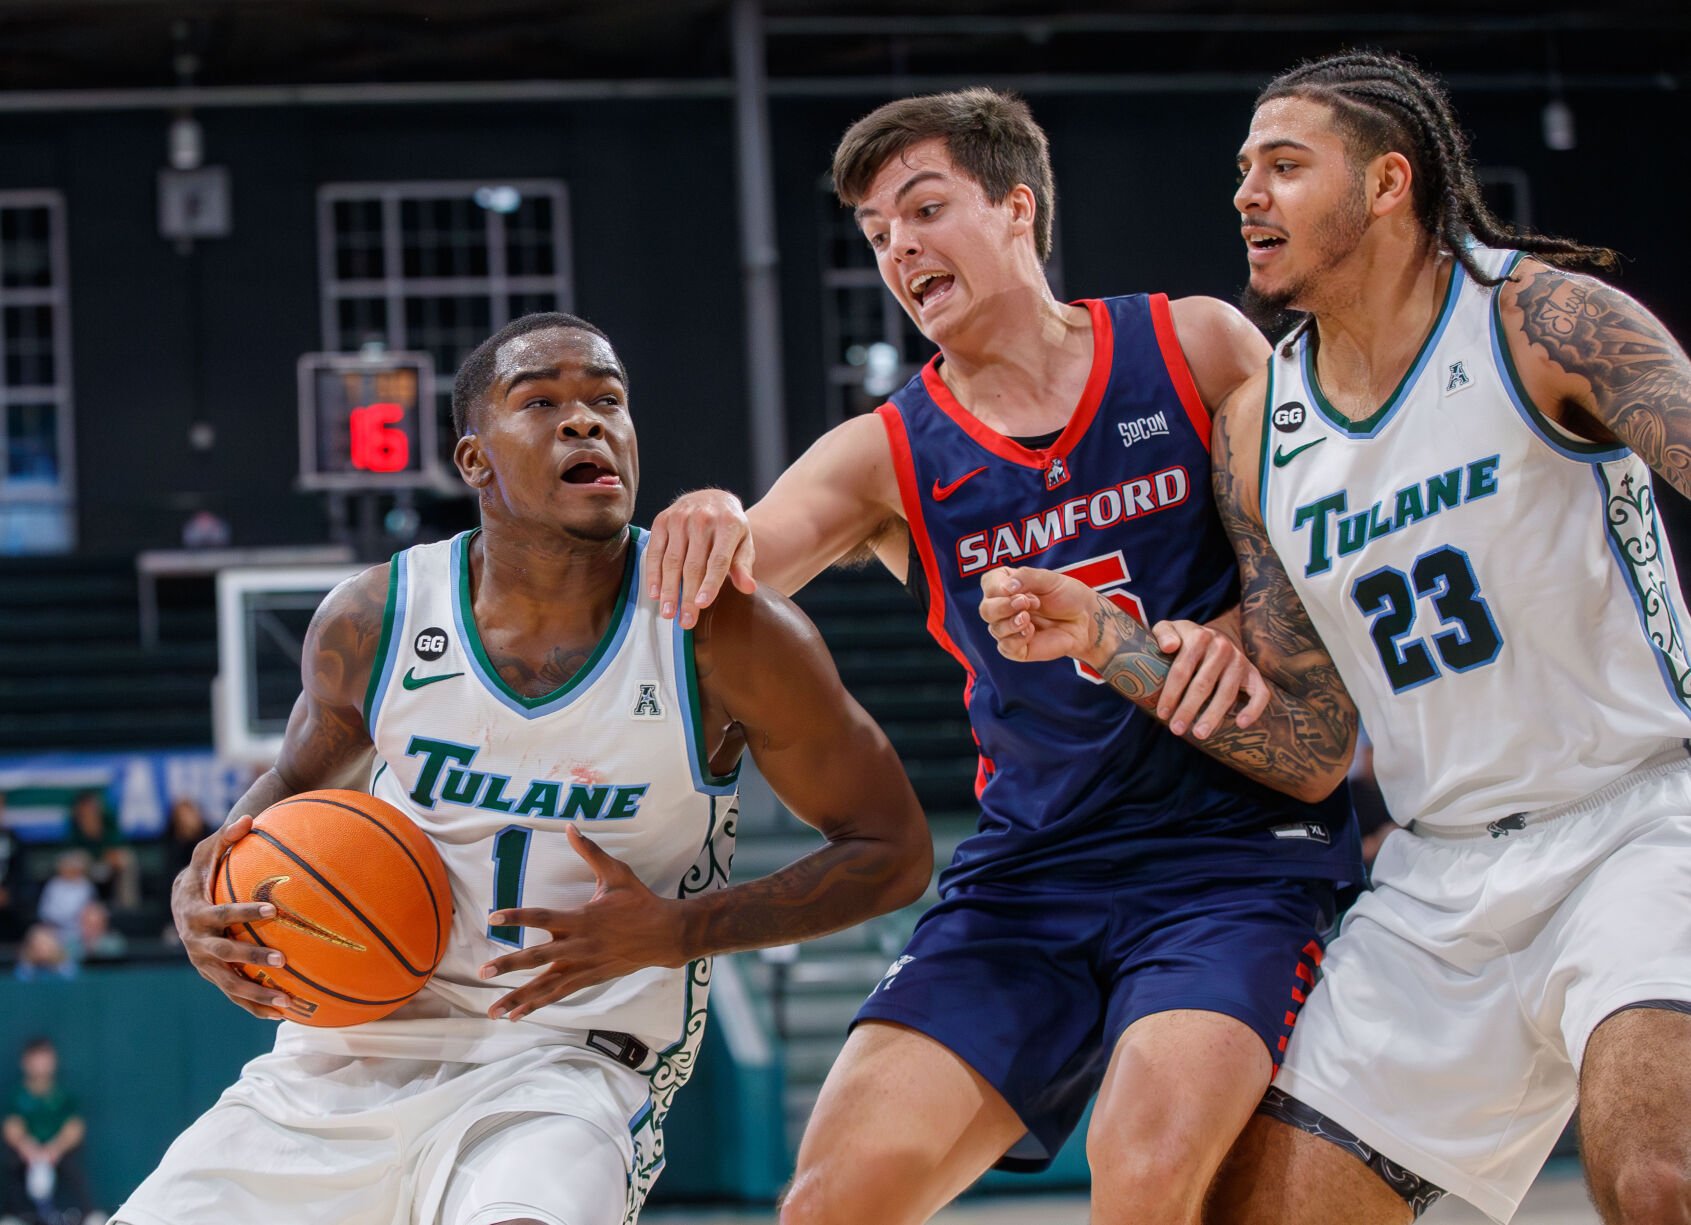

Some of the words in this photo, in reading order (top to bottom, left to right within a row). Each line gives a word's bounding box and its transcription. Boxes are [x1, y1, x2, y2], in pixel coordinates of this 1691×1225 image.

[1274, 406, 1304, 425] GG
[956, 465, 1191, 578] SAMFORD
[1292, 453, 1500, 579] TULANE
[416, 634, 445, 653] GG
[1351, 543, 1504, 695] 23
[404, 735, 651, 821] TULANE
[1309, 824, 1326, 837] XL
[487, 823, 534, 950] 1
